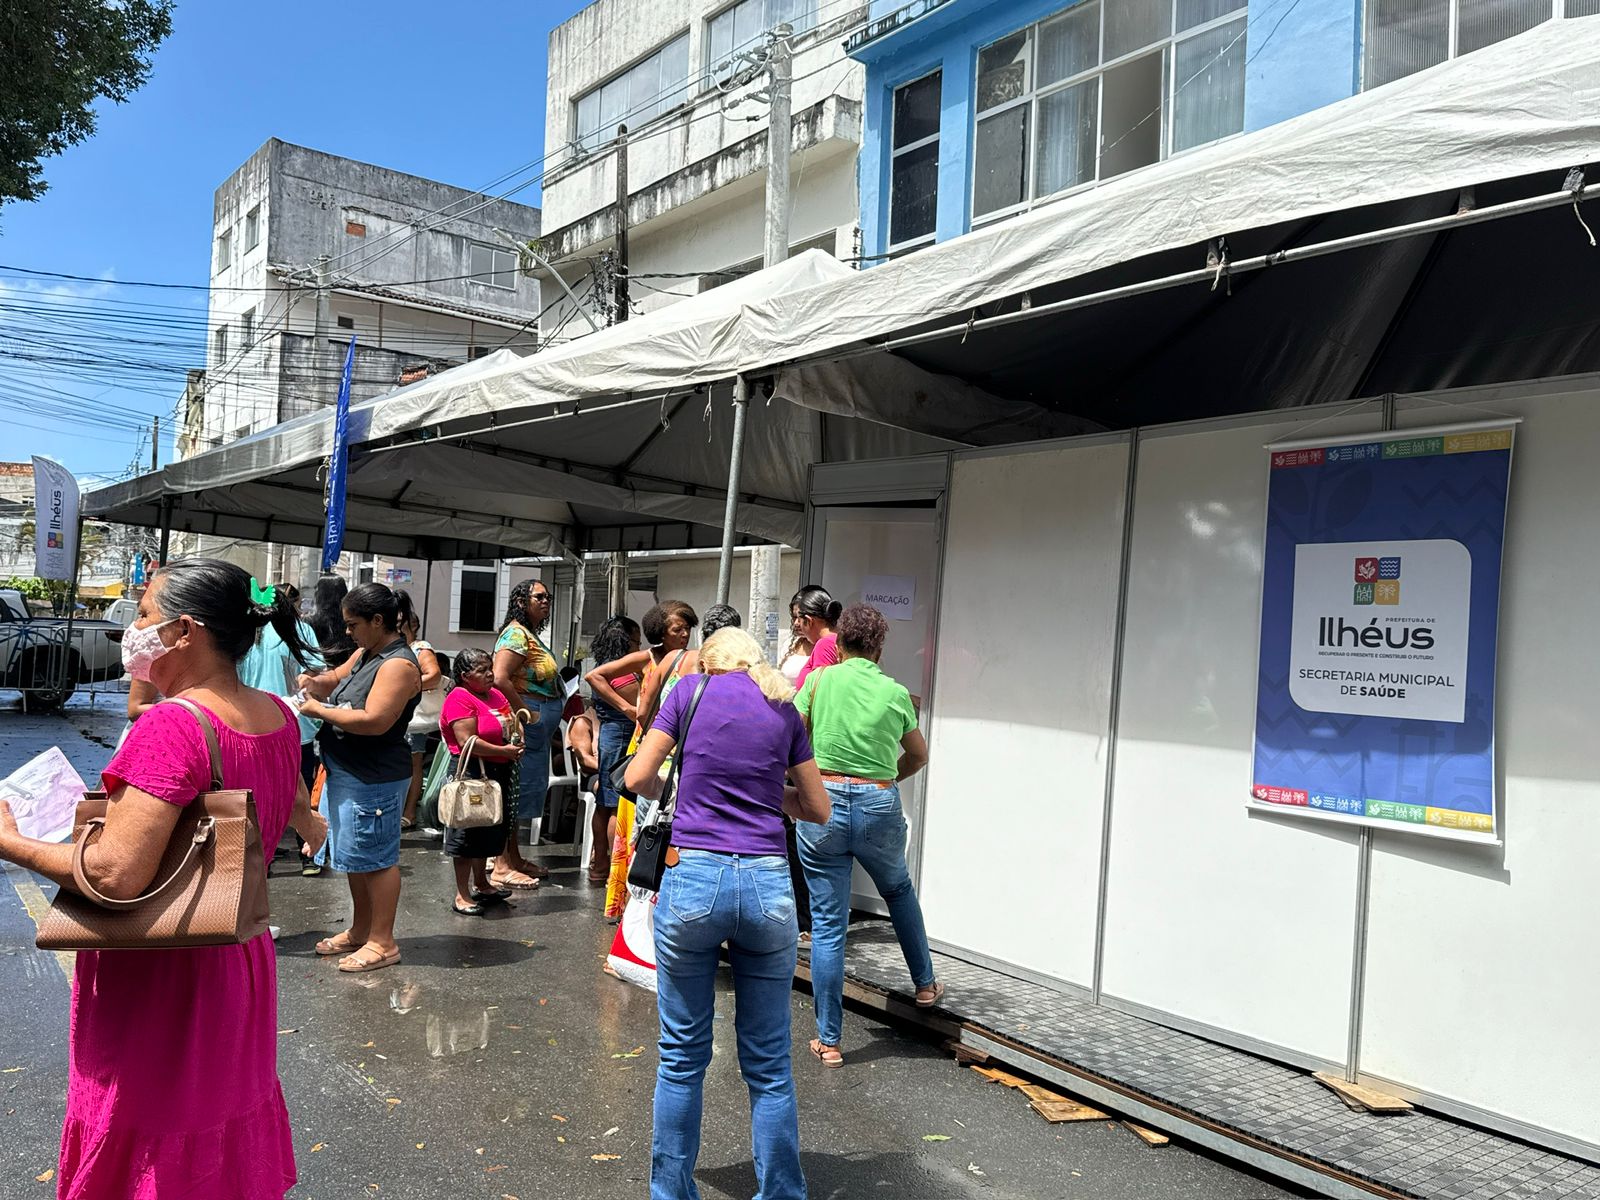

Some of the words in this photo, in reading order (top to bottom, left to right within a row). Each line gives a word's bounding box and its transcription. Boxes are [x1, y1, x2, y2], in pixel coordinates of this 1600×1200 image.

[50, 490, 61, 530] Ilhéus
[865, 594, 910, 605] MARCAÇÃO
[1319, 616, 1435, 650] Ilhéus
[1299, 668, 1375, 682] SECRETARIA
[1379, 672, 1455, 687] MUNICIPAL
[1340, 685, 1357, 695] DE
[1359, 684, 1406, 698] SAÚDE
